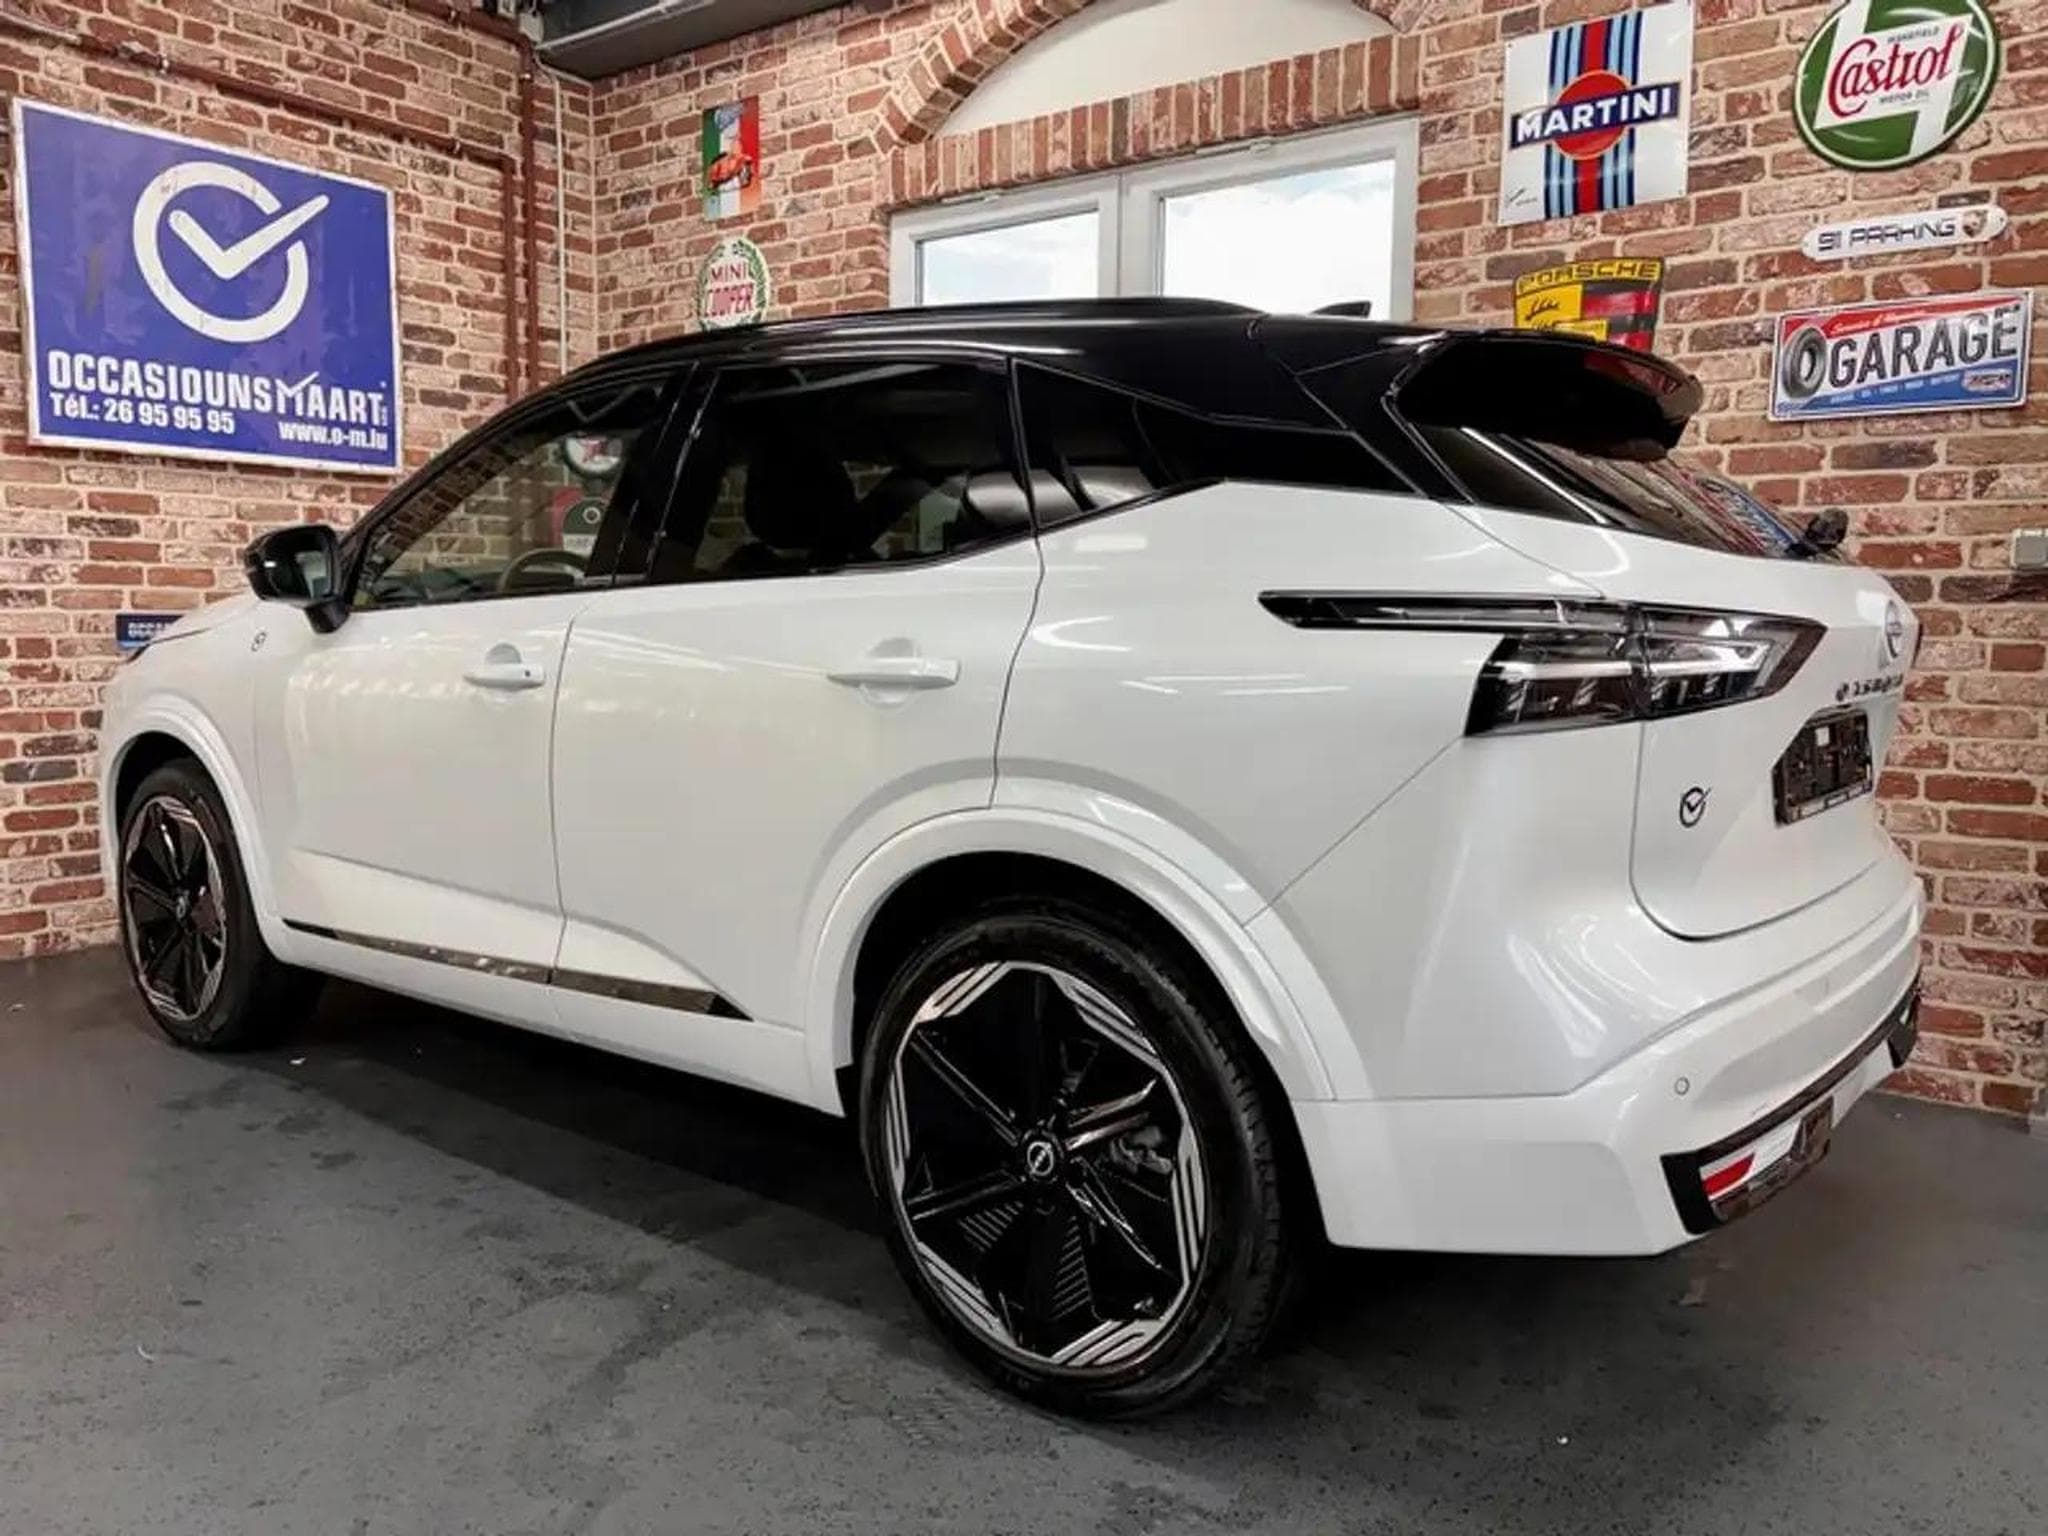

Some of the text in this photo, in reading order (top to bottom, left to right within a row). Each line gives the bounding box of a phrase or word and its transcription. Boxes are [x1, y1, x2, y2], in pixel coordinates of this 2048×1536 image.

[1828, 22, 1964, 119] Castrol
[1516, 87, 1672, 143] MARTINI
[1849, 217, 1956, 247] PARKING
[710, 262, 746, 282] MINI
[1518, 260, 1659, 294] PORSCHE
[1829, 304, 2020, 388] GARAGE
[104, 398, 133, 424] 26
[139, 402, 168, 428] 95
[173, 406, 202, 431] 95
[207, 410, 235, 435] 95
[278, 421, 388, 451] www.o-m.lu
